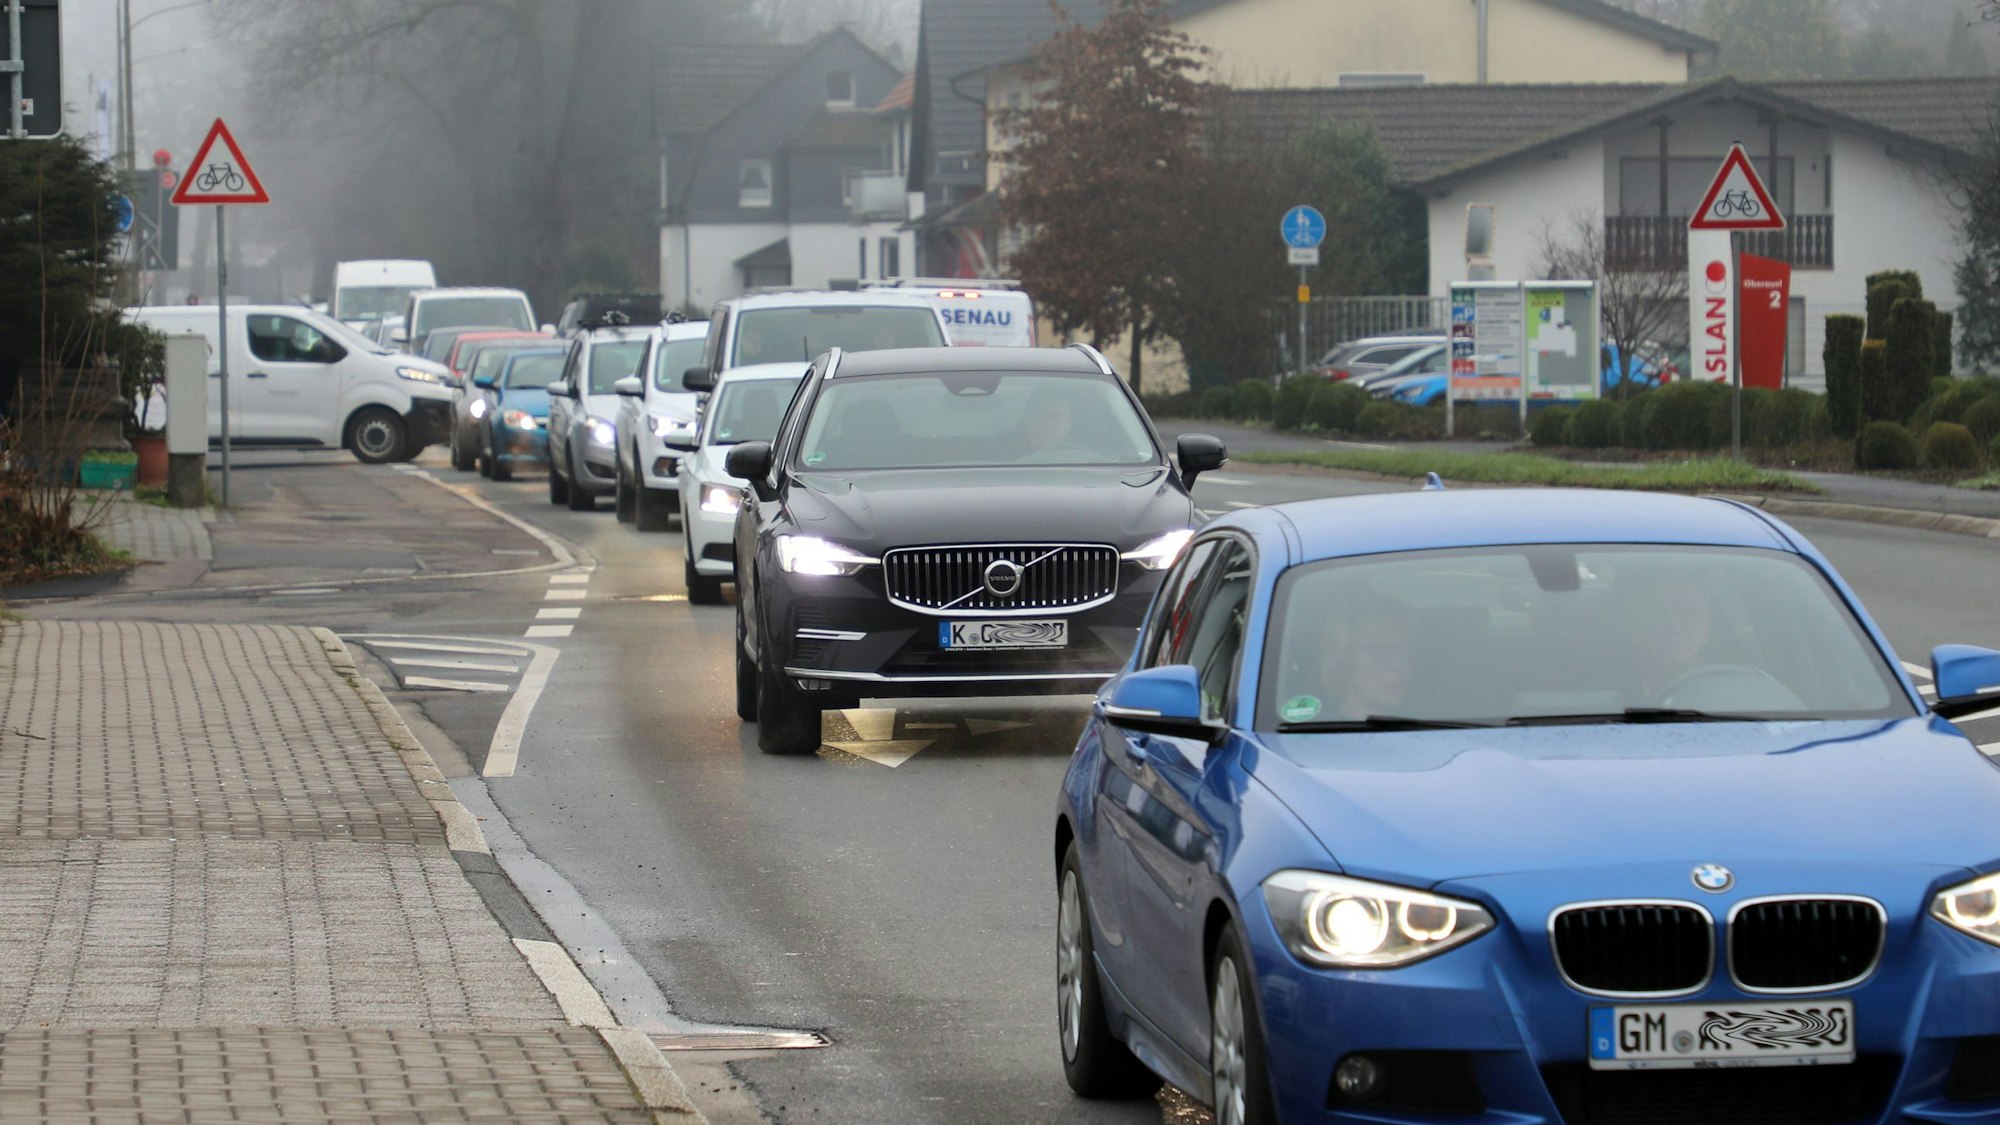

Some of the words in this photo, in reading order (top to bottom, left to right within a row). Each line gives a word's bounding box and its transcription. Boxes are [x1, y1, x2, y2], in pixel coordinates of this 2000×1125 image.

[1769, 290, 1782, 309] 2
[952, 624, 966, 644] K
[1619, 1012, 1667, 1052] GM
